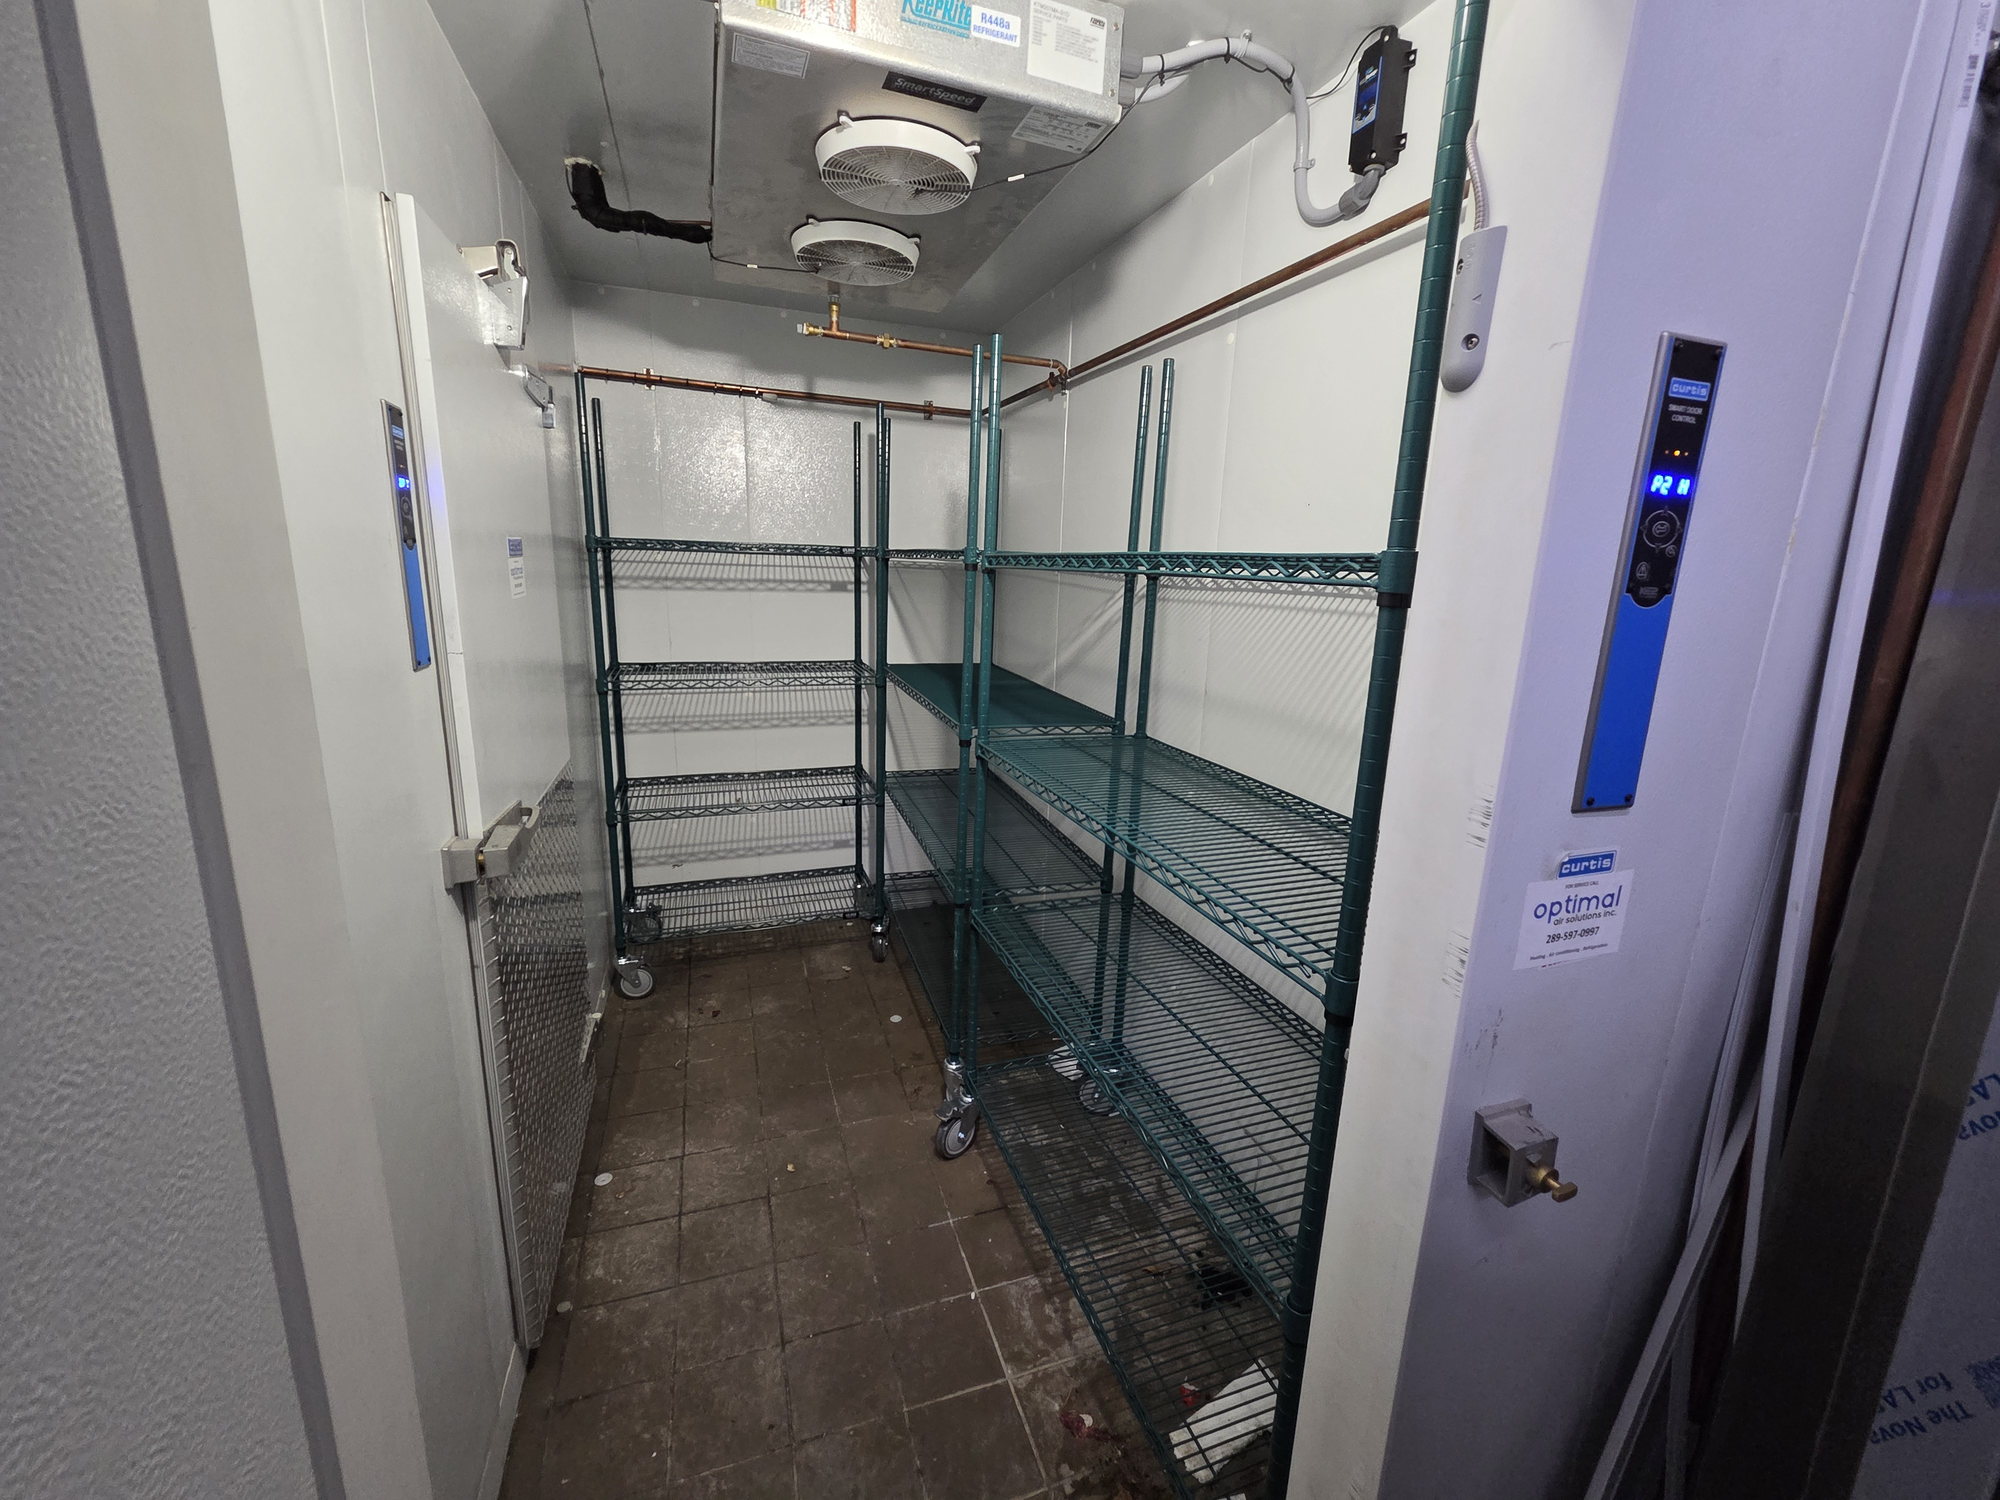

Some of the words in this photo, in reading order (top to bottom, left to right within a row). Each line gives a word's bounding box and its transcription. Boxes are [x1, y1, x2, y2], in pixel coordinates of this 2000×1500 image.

[981, 12, 1010, 30] R448a
[973, 24, 1018, 43] REFRIGERANT
[894, 78, 977, 105] SmartSpeed
[1672, 384, 1707, 396] curtis
[1561, 857, 1612, 874] curtis
[1533, 885, 1623, 925] optimal
[1553, 917, 1564, 926] air
[1565, 911, 1602, 924] solutions
[1603, 909, 1617, 918] inc.
[1545, 926, 1600, 945] 289-597-0997
[1916, 1372, 1954, 1395] for
[1879, 1385, 1916, 1413] LA
[1926, 1401, 1975, 1424] The
